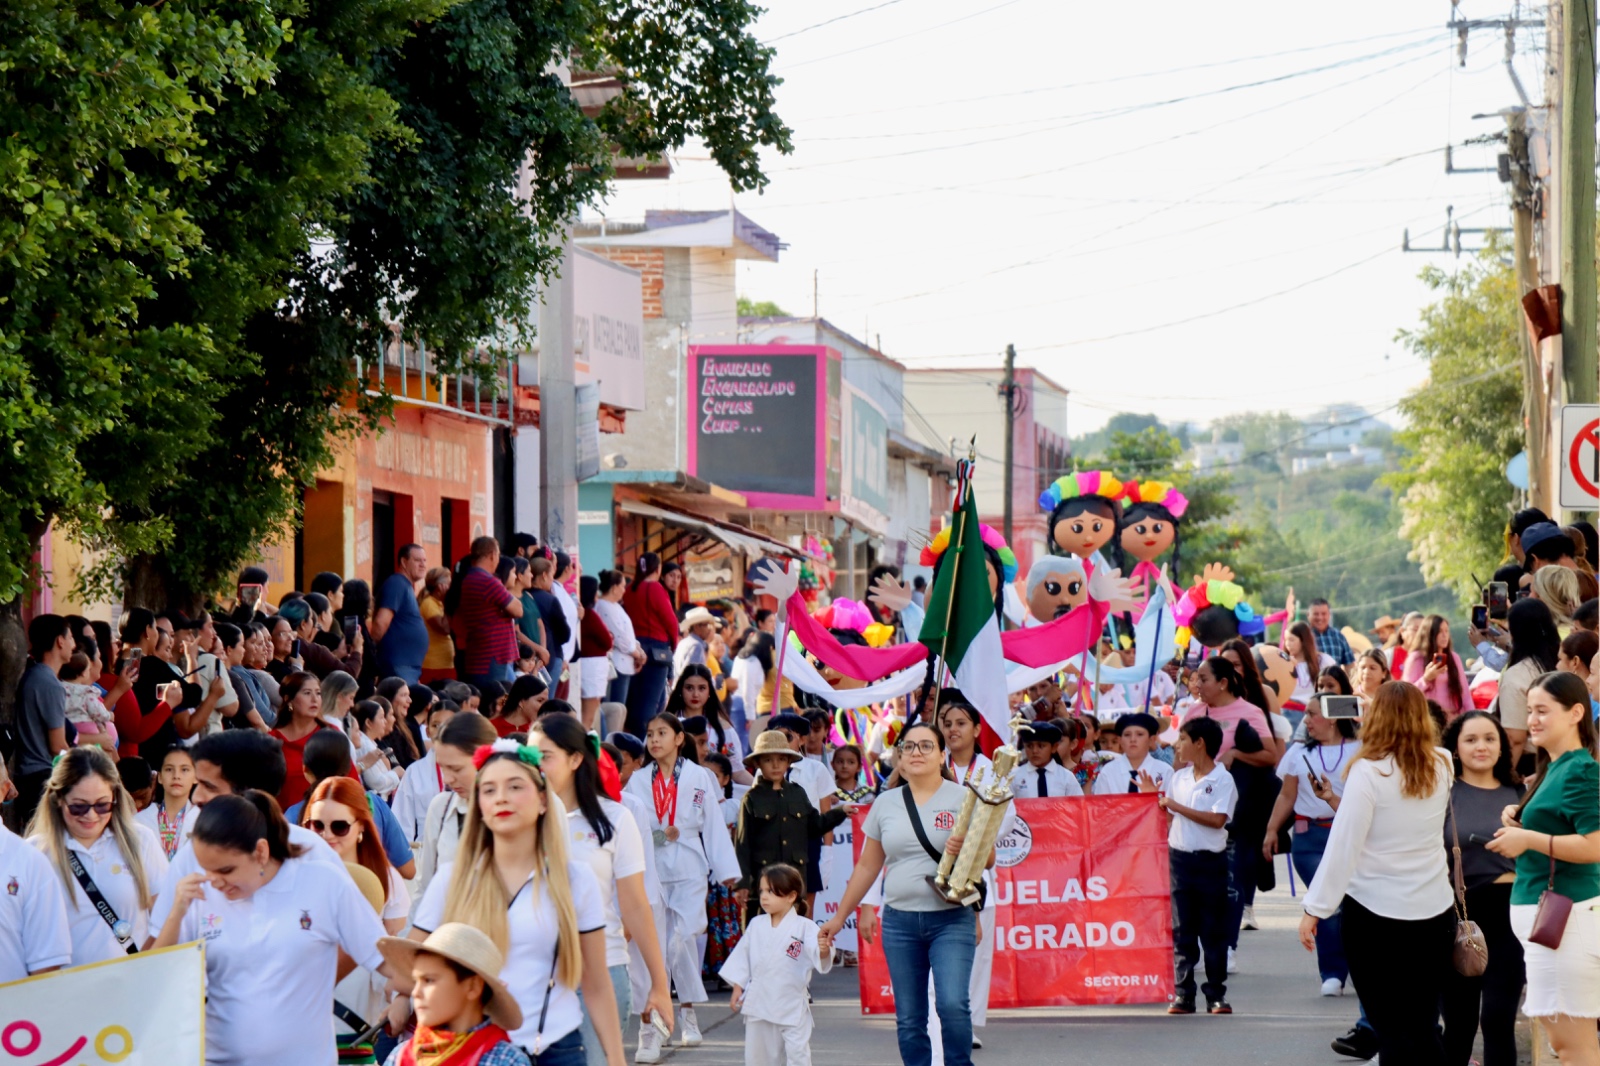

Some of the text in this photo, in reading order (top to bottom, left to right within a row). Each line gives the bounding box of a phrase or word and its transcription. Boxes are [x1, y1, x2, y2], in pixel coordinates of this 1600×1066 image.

[995, 876, 1108, 906] UELAS
[996, 920, 1136, 952] IGRADO
[1084, 974, 1159, 988] SECTOR IV
